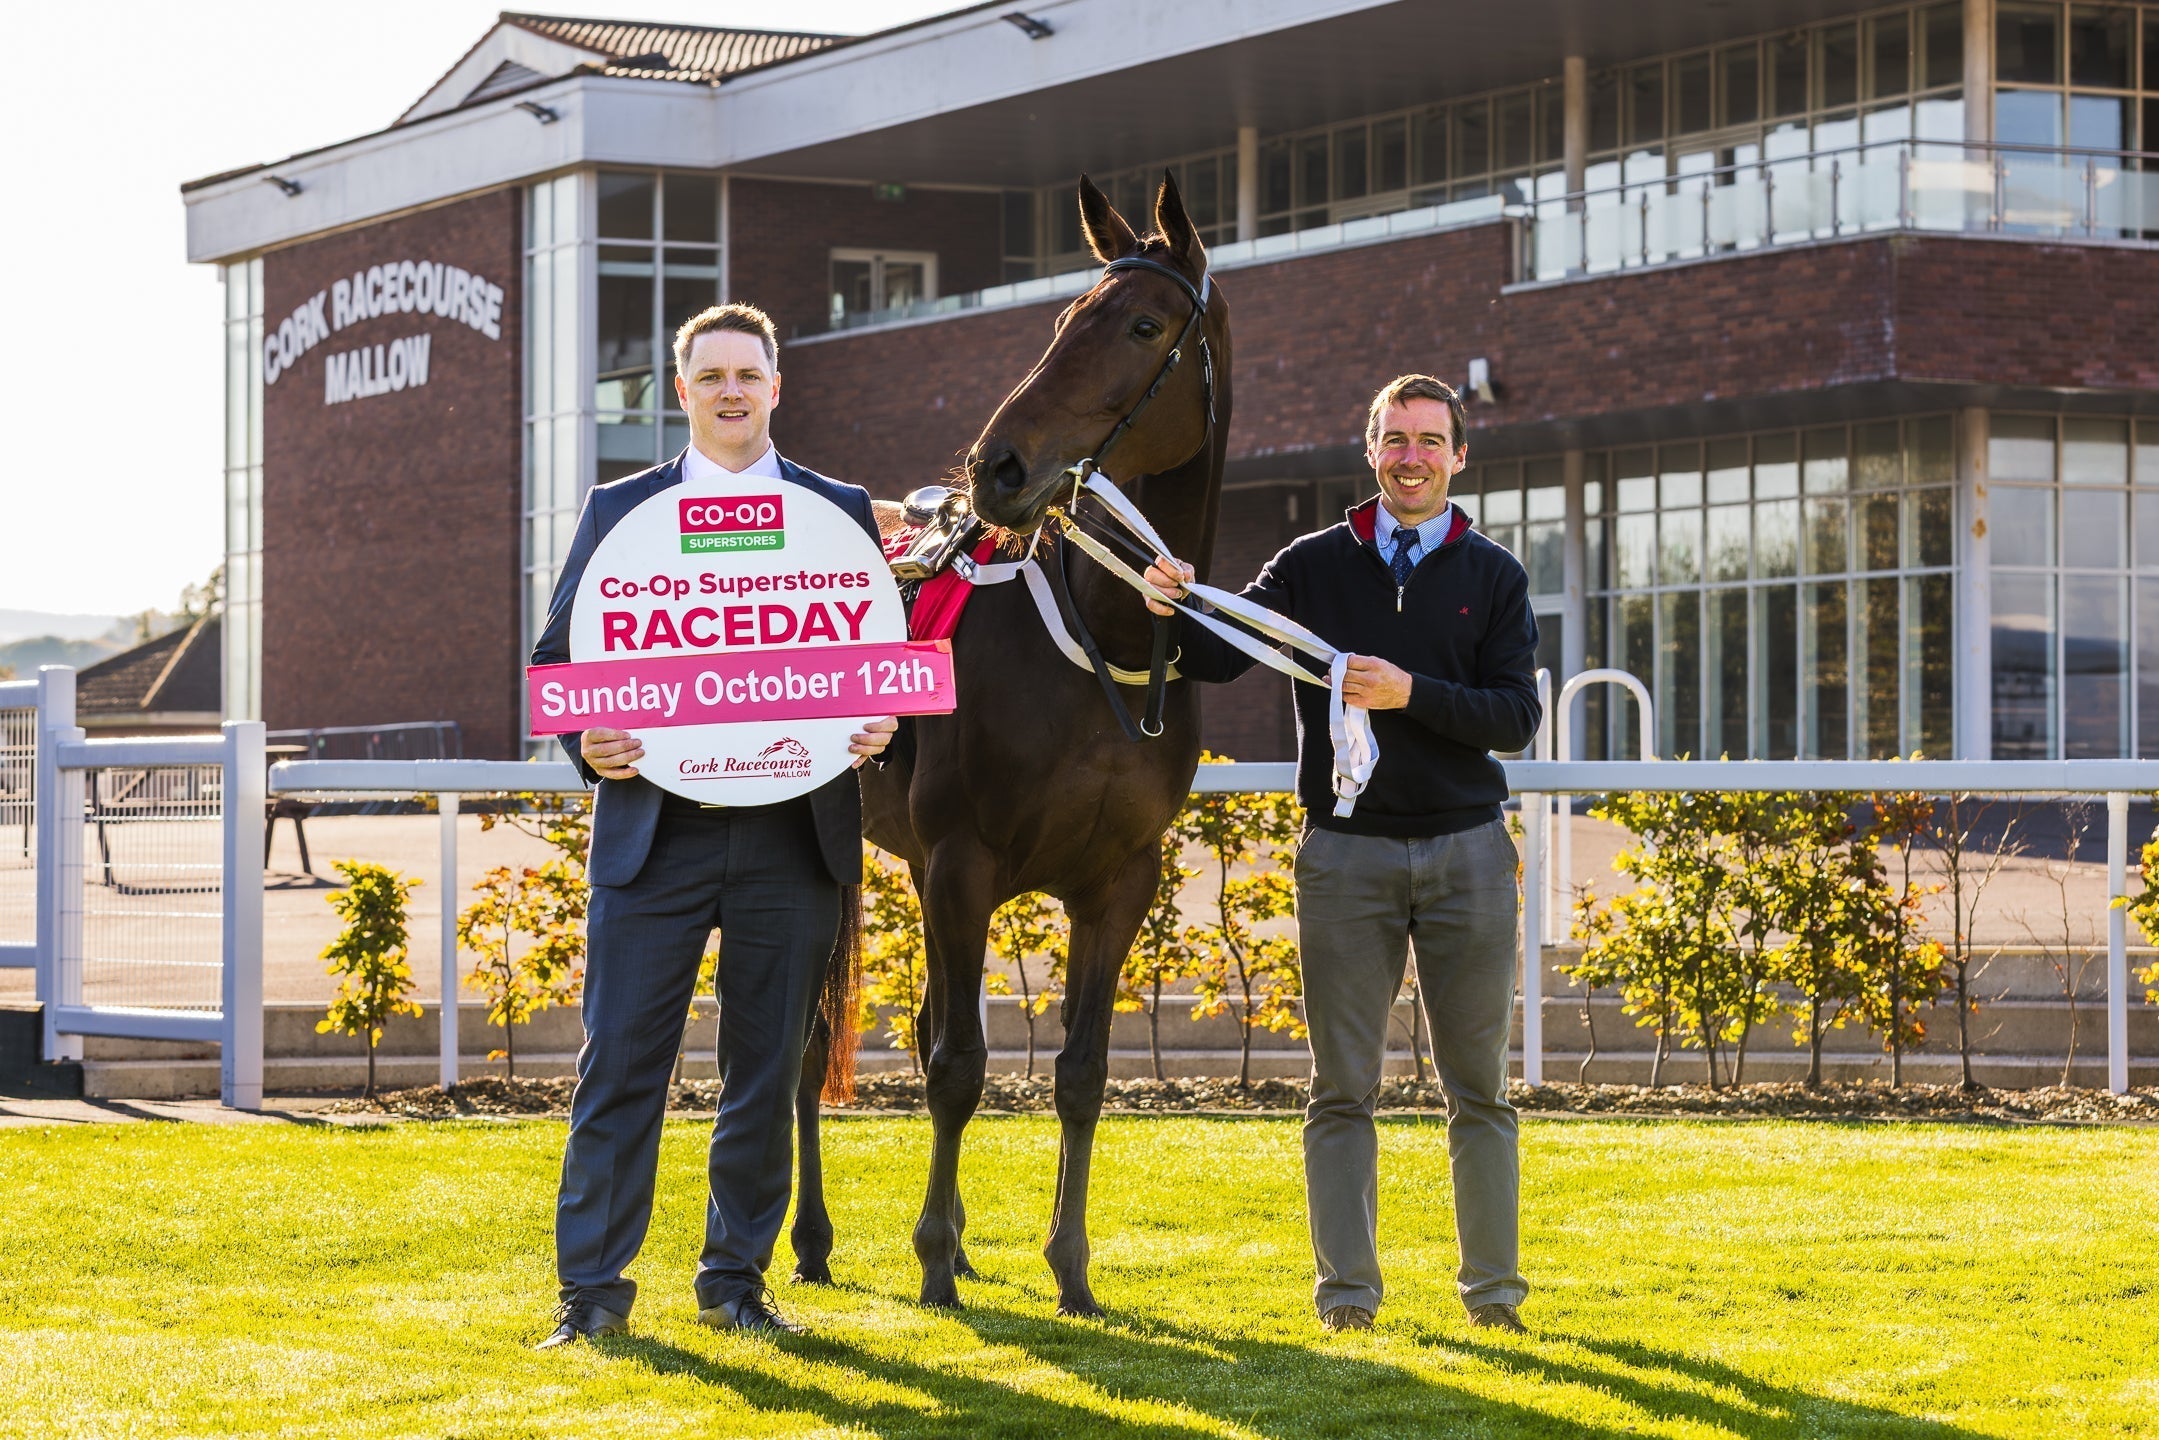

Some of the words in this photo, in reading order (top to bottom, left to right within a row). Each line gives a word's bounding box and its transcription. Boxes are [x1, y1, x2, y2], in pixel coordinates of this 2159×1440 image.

[265, 290, 329, 384] CORK
[332, 260, 504, 341] RACECOURSE
[325, 332, 432, 405] MALLOW
[689, 535, 777, 549] SUPERSTORES
[600, 575, 690, 601] Co-Op
[699, 570, 870, 598] Superstores
[603, 600, 872, 651] RACEDAY
[541, 676, 682, 718] Sunday
[695, 662, 845, 704] October
[856, 659, 935, 695] 12th
[679, 759, 718, 774] Cork
[723, 756, 812, 772] Racecourse
[773, 770, 811, 779] MALLOW
